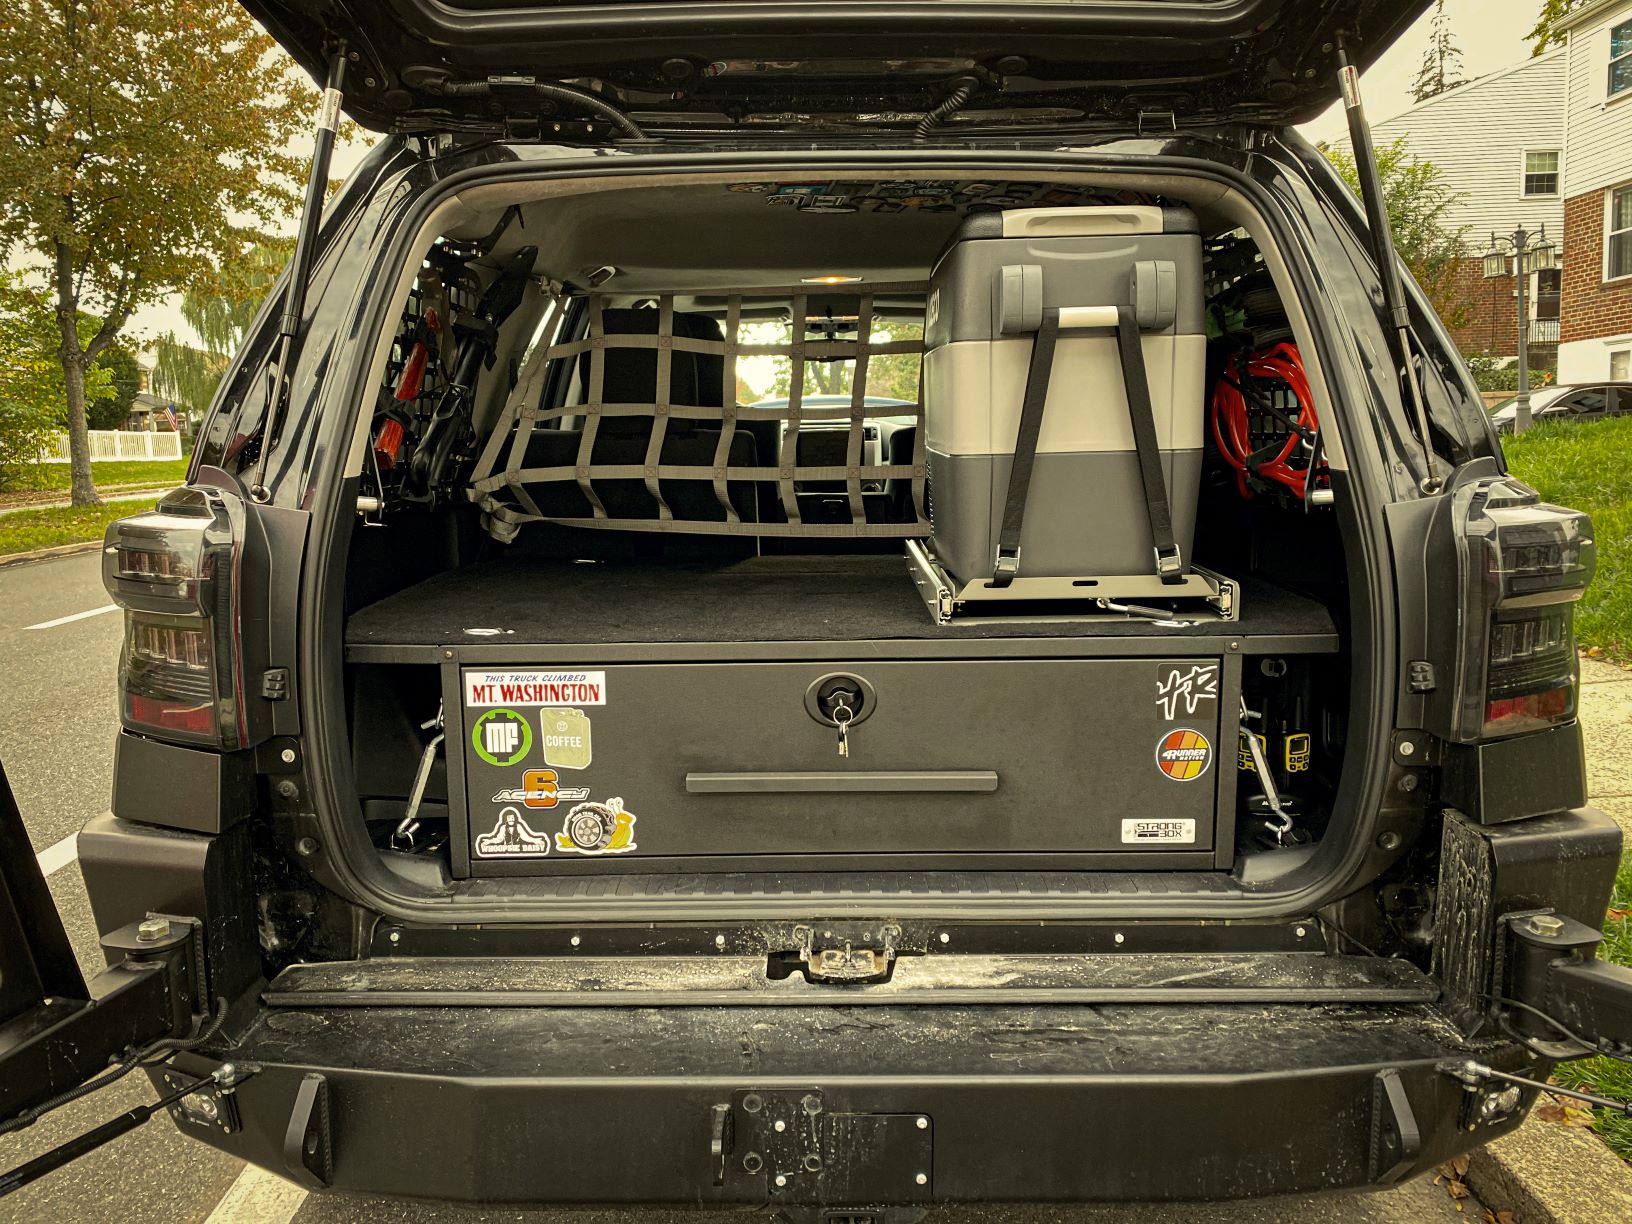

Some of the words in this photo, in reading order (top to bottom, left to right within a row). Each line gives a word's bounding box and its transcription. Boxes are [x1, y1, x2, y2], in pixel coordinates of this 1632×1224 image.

[485, 675, 504, 683] THIS
[541, 674, 587, 682] CLIMBED
[472, 684, 498, 703] MT.
[500, 683, 600, 702] WASHINGTON
[545, 735, 583, 748] COFFEE
[1162, 748, 1207, 760] 4RUNNER
[1137, 822, 1183, 830] STRONG
[480, 844, 521, 853] WHOOPSIE
[522, 843, 546, 852] DAISY
